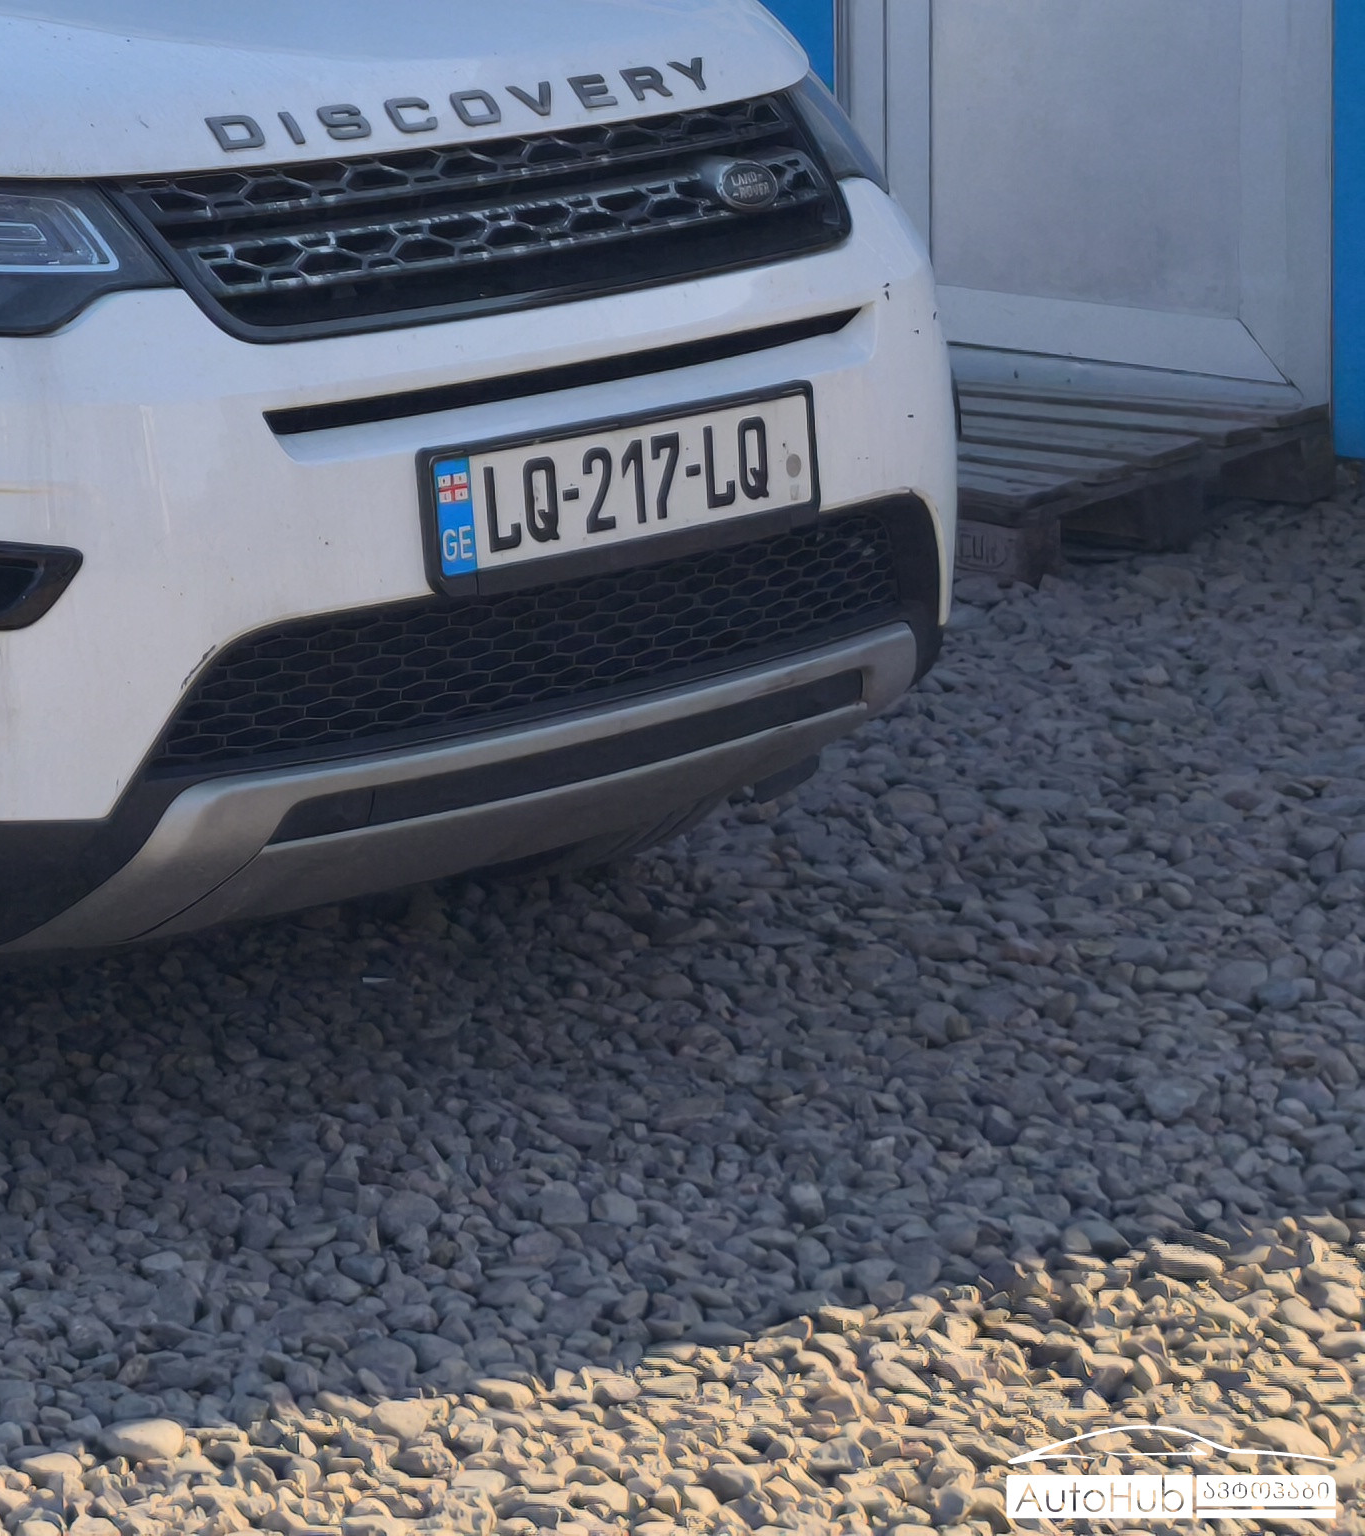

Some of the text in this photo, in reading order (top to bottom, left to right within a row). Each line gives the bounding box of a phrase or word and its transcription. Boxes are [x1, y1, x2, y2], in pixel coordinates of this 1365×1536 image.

[204, 56, 711, 152] DISCOVERY
[483, 415, 770, 553] LQ-217-LQ
[441, 525, 473, 562] GE
